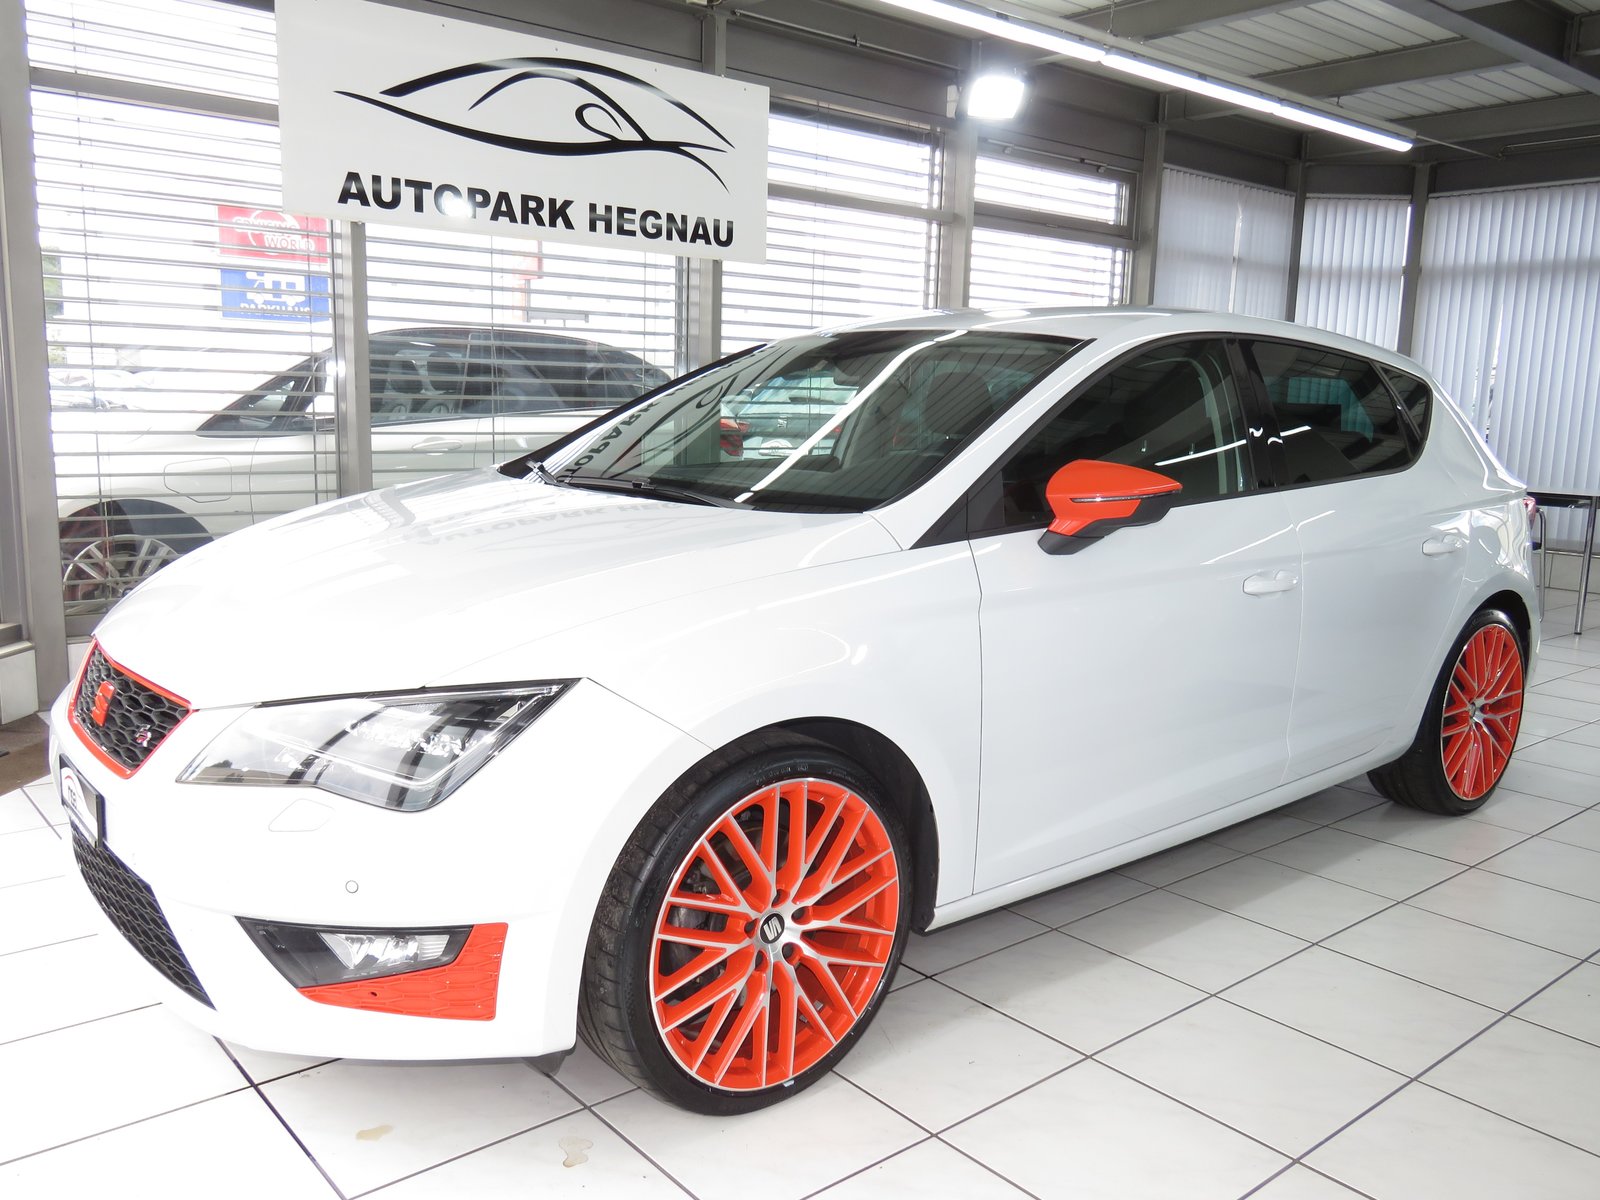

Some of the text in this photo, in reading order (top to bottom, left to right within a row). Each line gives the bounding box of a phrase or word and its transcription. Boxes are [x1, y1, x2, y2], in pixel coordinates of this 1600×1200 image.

[337, 171, 734, 248] AUTOPARK HEGNAU
[265, 235, 315, 252] WORLD
